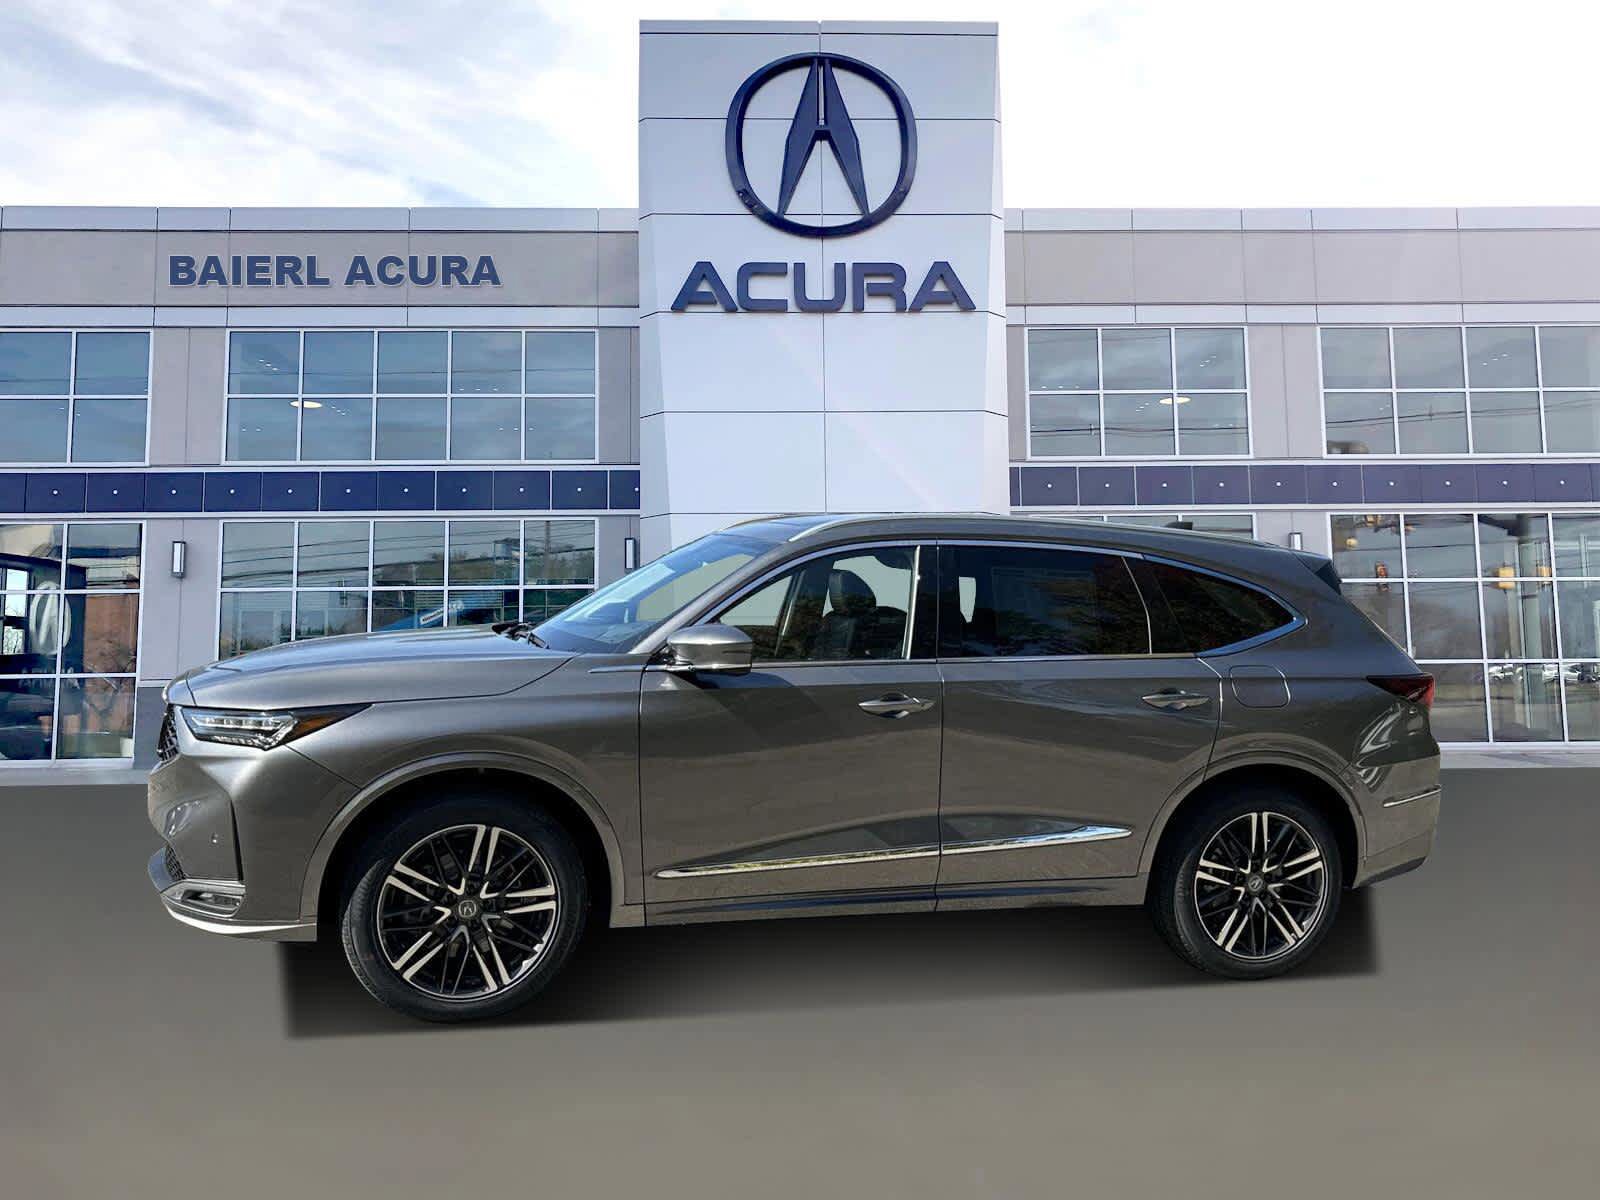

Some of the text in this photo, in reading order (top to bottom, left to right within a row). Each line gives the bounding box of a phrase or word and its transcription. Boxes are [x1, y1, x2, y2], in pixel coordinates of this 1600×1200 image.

[168, 255, 502, 287] BAIERL ACURA
[670, 261, 977, 313] ACURA
